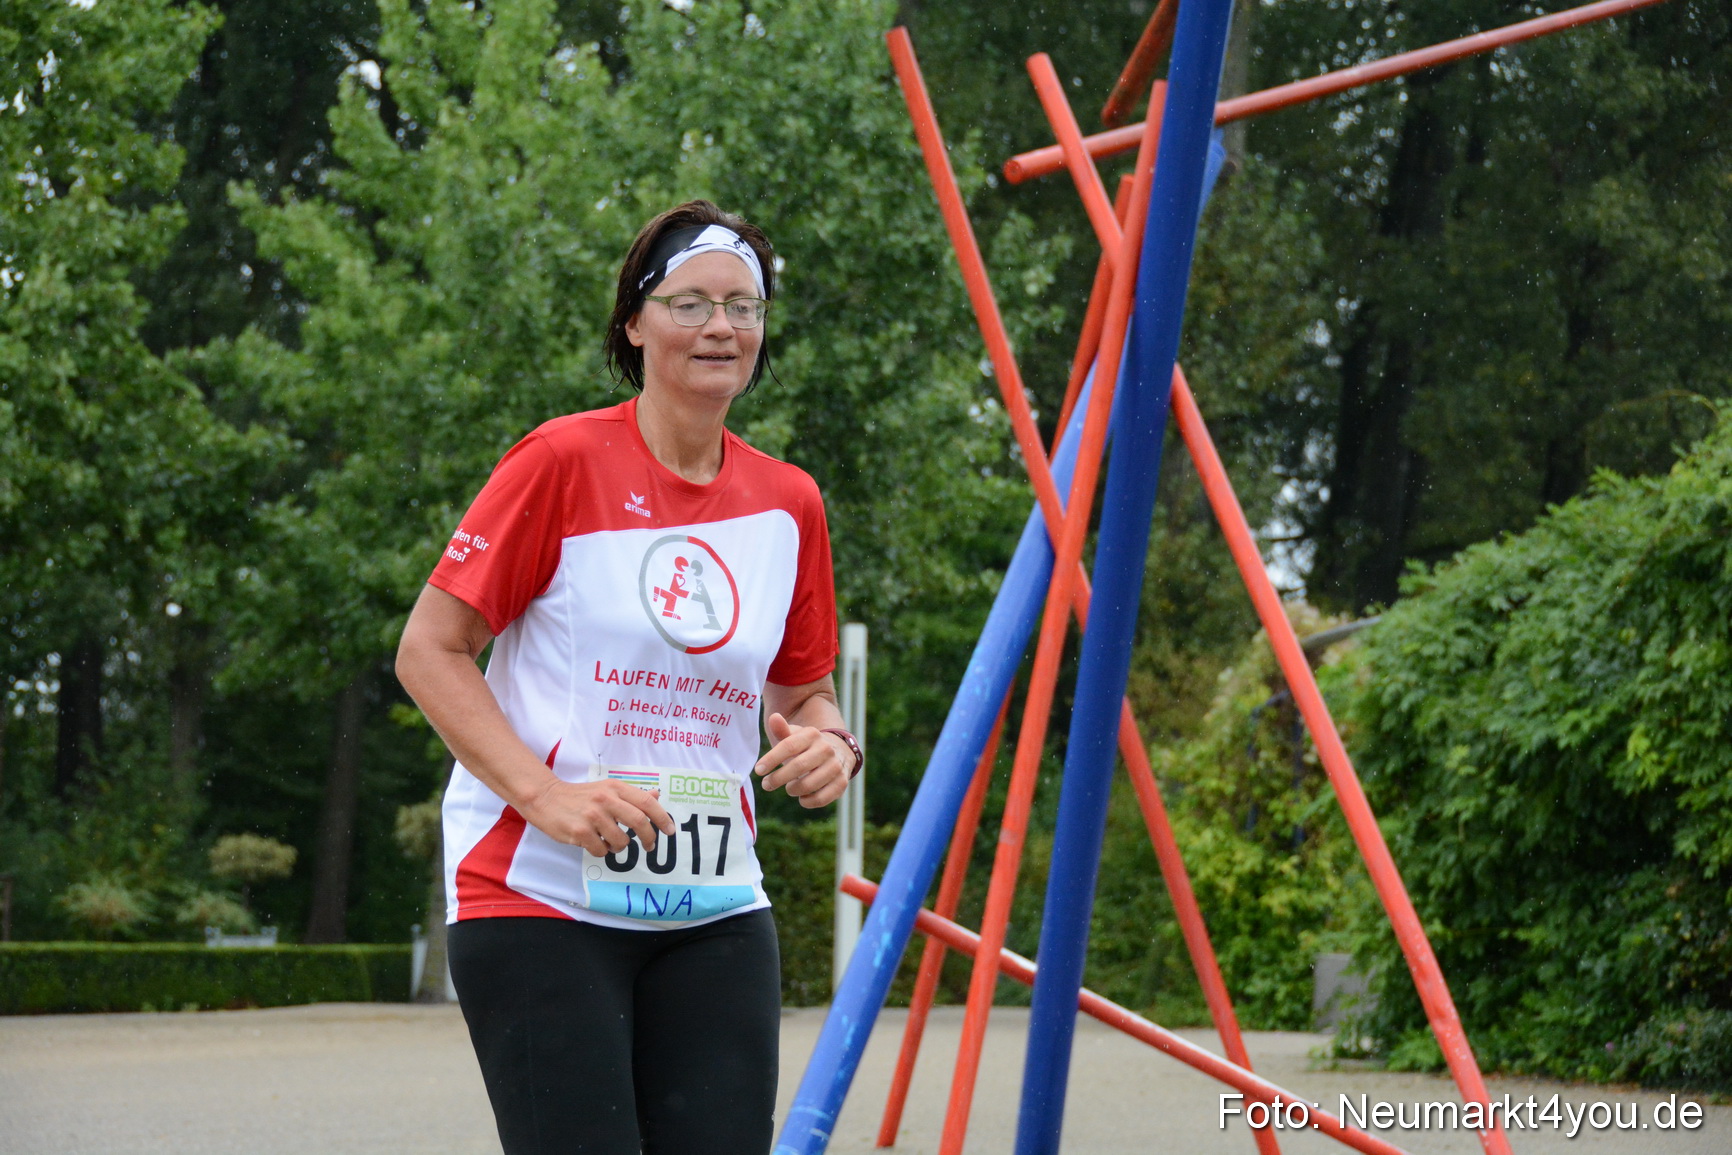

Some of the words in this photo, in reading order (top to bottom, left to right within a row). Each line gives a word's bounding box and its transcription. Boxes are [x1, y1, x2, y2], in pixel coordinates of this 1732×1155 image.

[624, 502, 651, 518] erima
[446, 545, 468, 563] Rosi
[472, 535, 490, 552] für
[594, 660, 671, 690] LAUFEN
[675, 676, 705, 694] MIT
[708, 679, 758, 710] HERZ
[608, 698, 625, 712] Dr.
[629, 698, 665, 716] Heck
[673, 705, 688, 719] Dr.
[691, 707, 732, 727] Röschl
[604, 720, 721, 749] Leistungsdiagnostik
[669, 775, 730, 799] BOCK
[625, 885, 692, 917] INA
